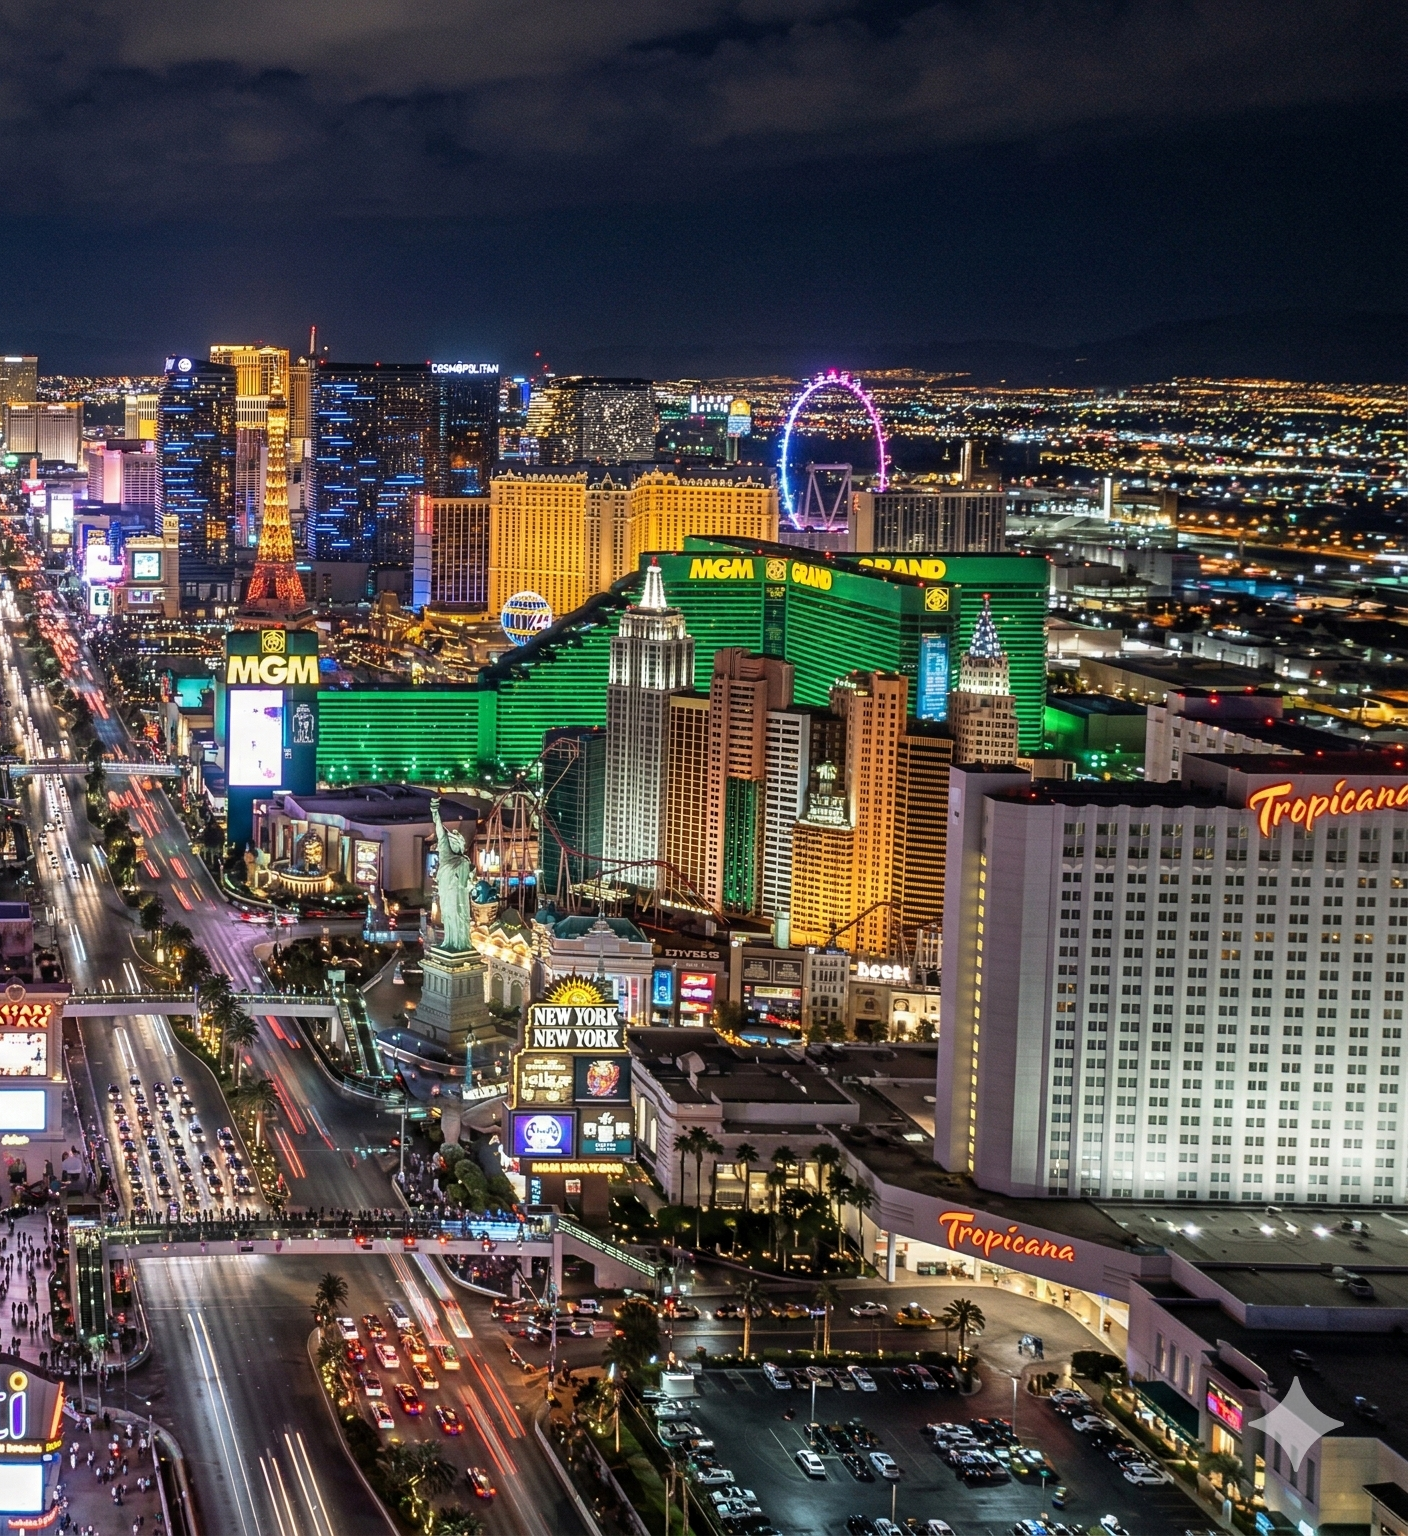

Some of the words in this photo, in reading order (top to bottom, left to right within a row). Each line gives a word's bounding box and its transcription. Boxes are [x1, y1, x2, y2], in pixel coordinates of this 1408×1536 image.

[689, 559, 754, 580] MGM
[791, 562, 833, 591] GRAND
[226, 655, 320, 685] MGM
[1249, 779, 1408, 838] Tropicana
[533, 1007, 573, 1027] NEW
[574, 1007, 619, 1027] YORK
[533, 1028, 573, 1048] NEW
[574, 1028, 620, 1048] YORK
[939, 1212, 1075, 1263] Tropicana
